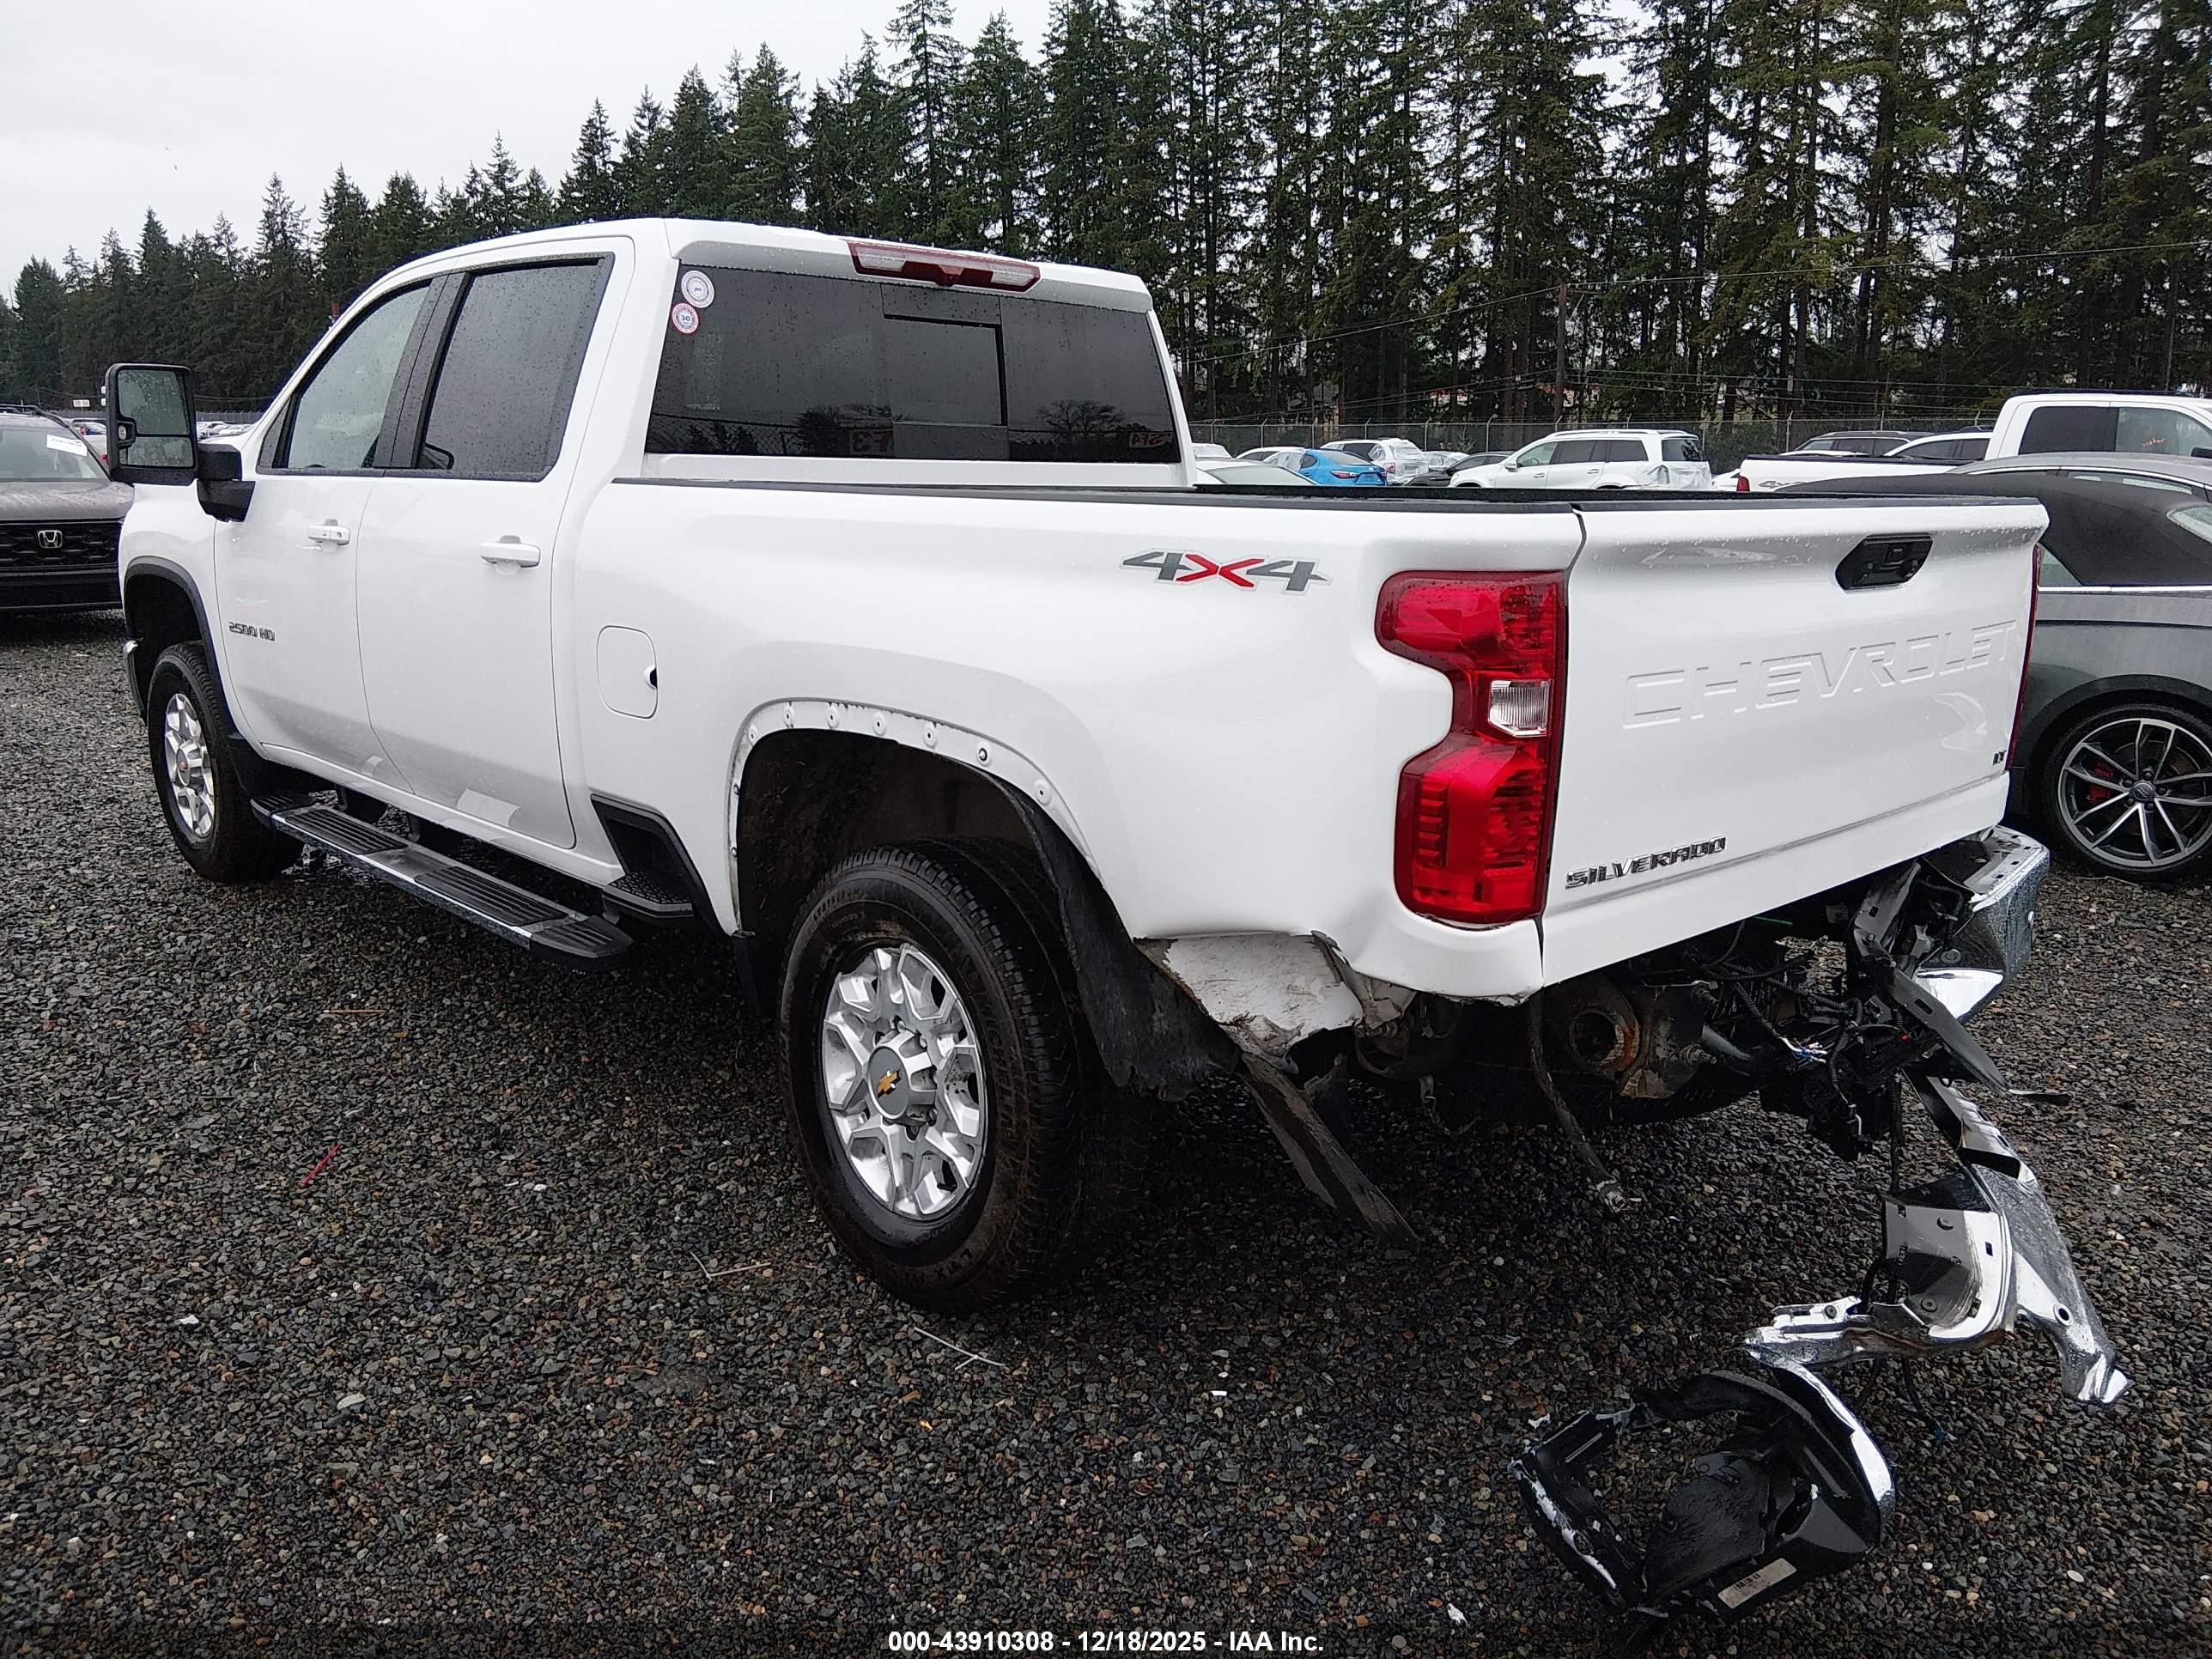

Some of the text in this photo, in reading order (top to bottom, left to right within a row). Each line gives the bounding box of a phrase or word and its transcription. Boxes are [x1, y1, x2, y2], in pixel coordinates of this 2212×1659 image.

[228, 621, 276, 641] 2500 HD
[1622, 619, 2016, 729] CHEVROLET
[1565, 836, 1728, 890] SILVERADO
